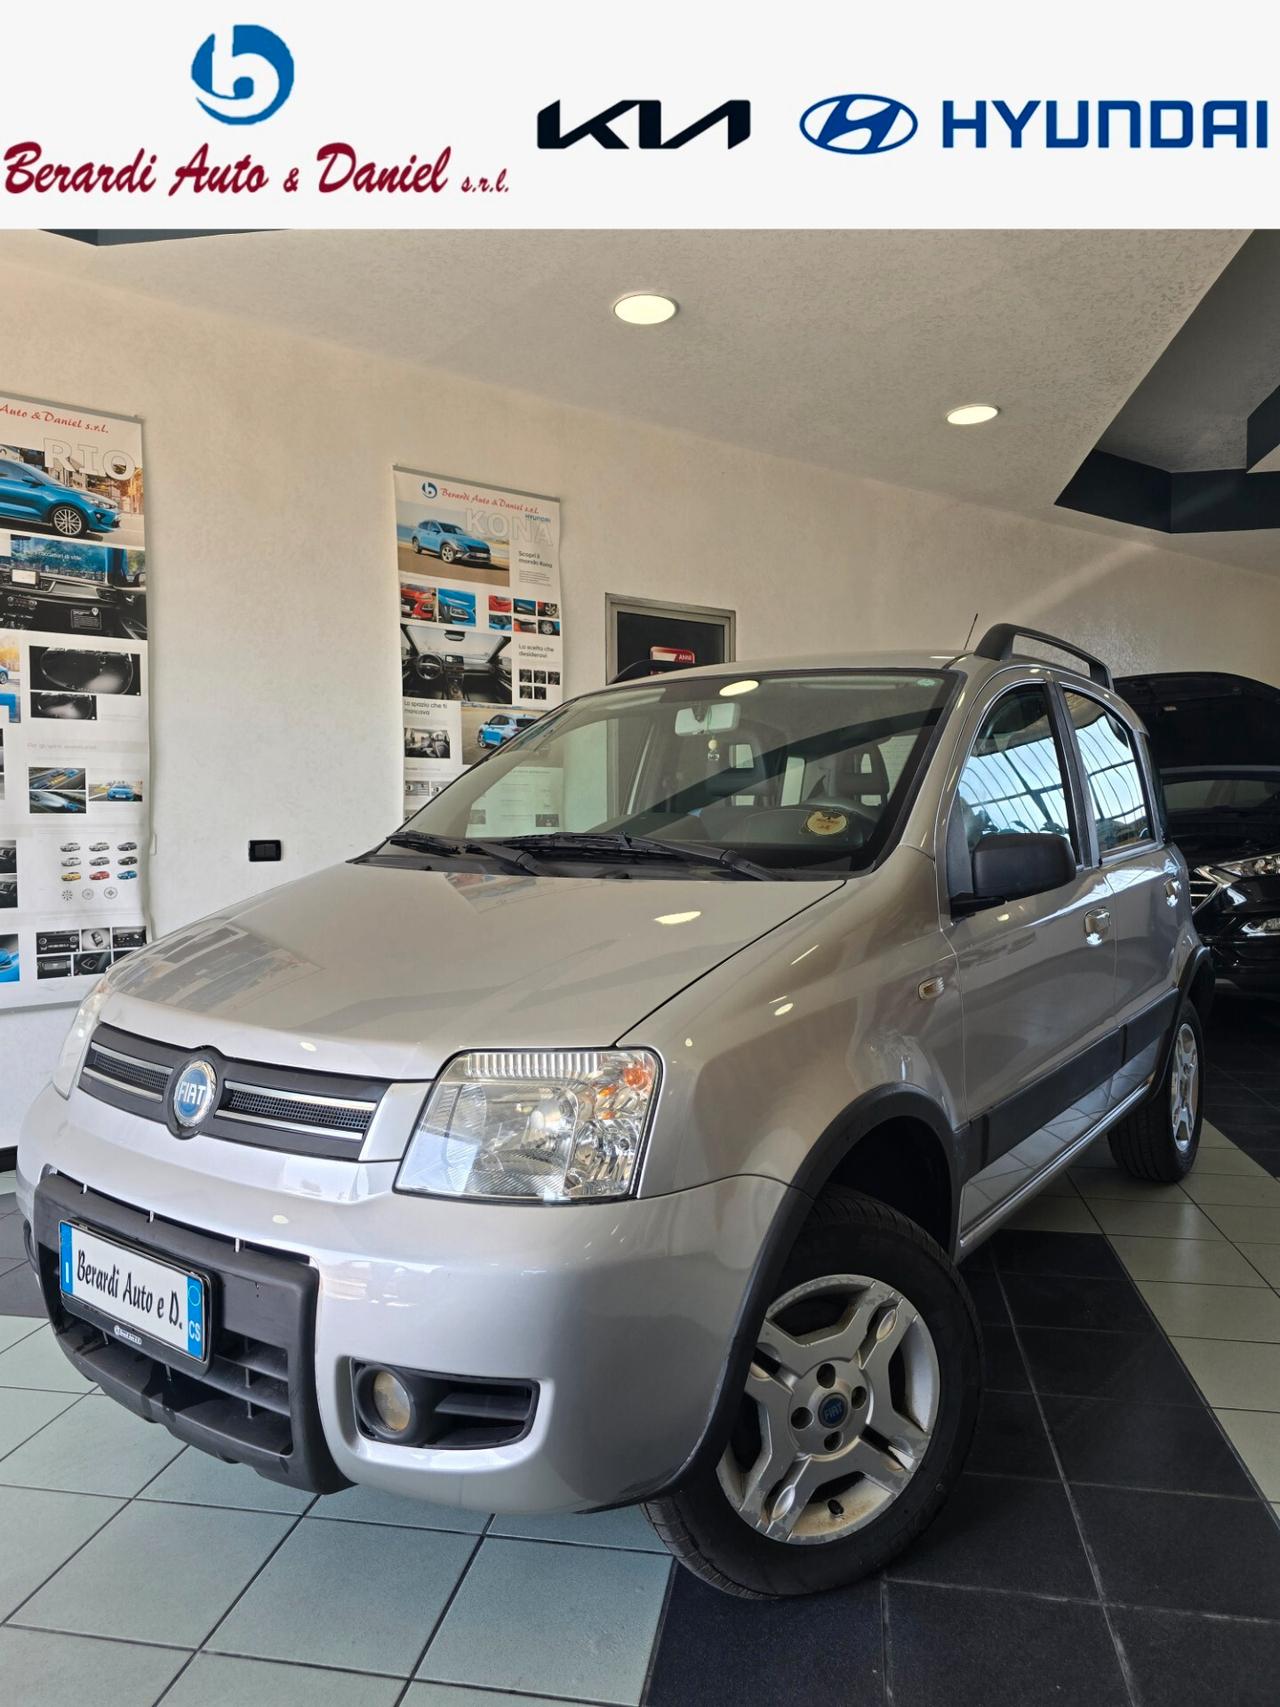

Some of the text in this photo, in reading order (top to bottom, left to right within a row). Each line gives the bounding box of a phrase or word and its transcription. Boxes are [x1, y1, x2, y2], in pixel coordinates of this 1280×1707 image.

[0, 404, 28, 418] Auto
[41, 410, 82, 428] Daniel
[440, 487, 470, 501] Berardi
[464, 508, 554, 547] KONA
[178, 1081, 207, 1105] FIAT
[77, 1249, 184, 1330] Berardi Auto e D.
[188, 1320, 201, 1342] CS
[824, 1401, 844, 1420] FIAT
